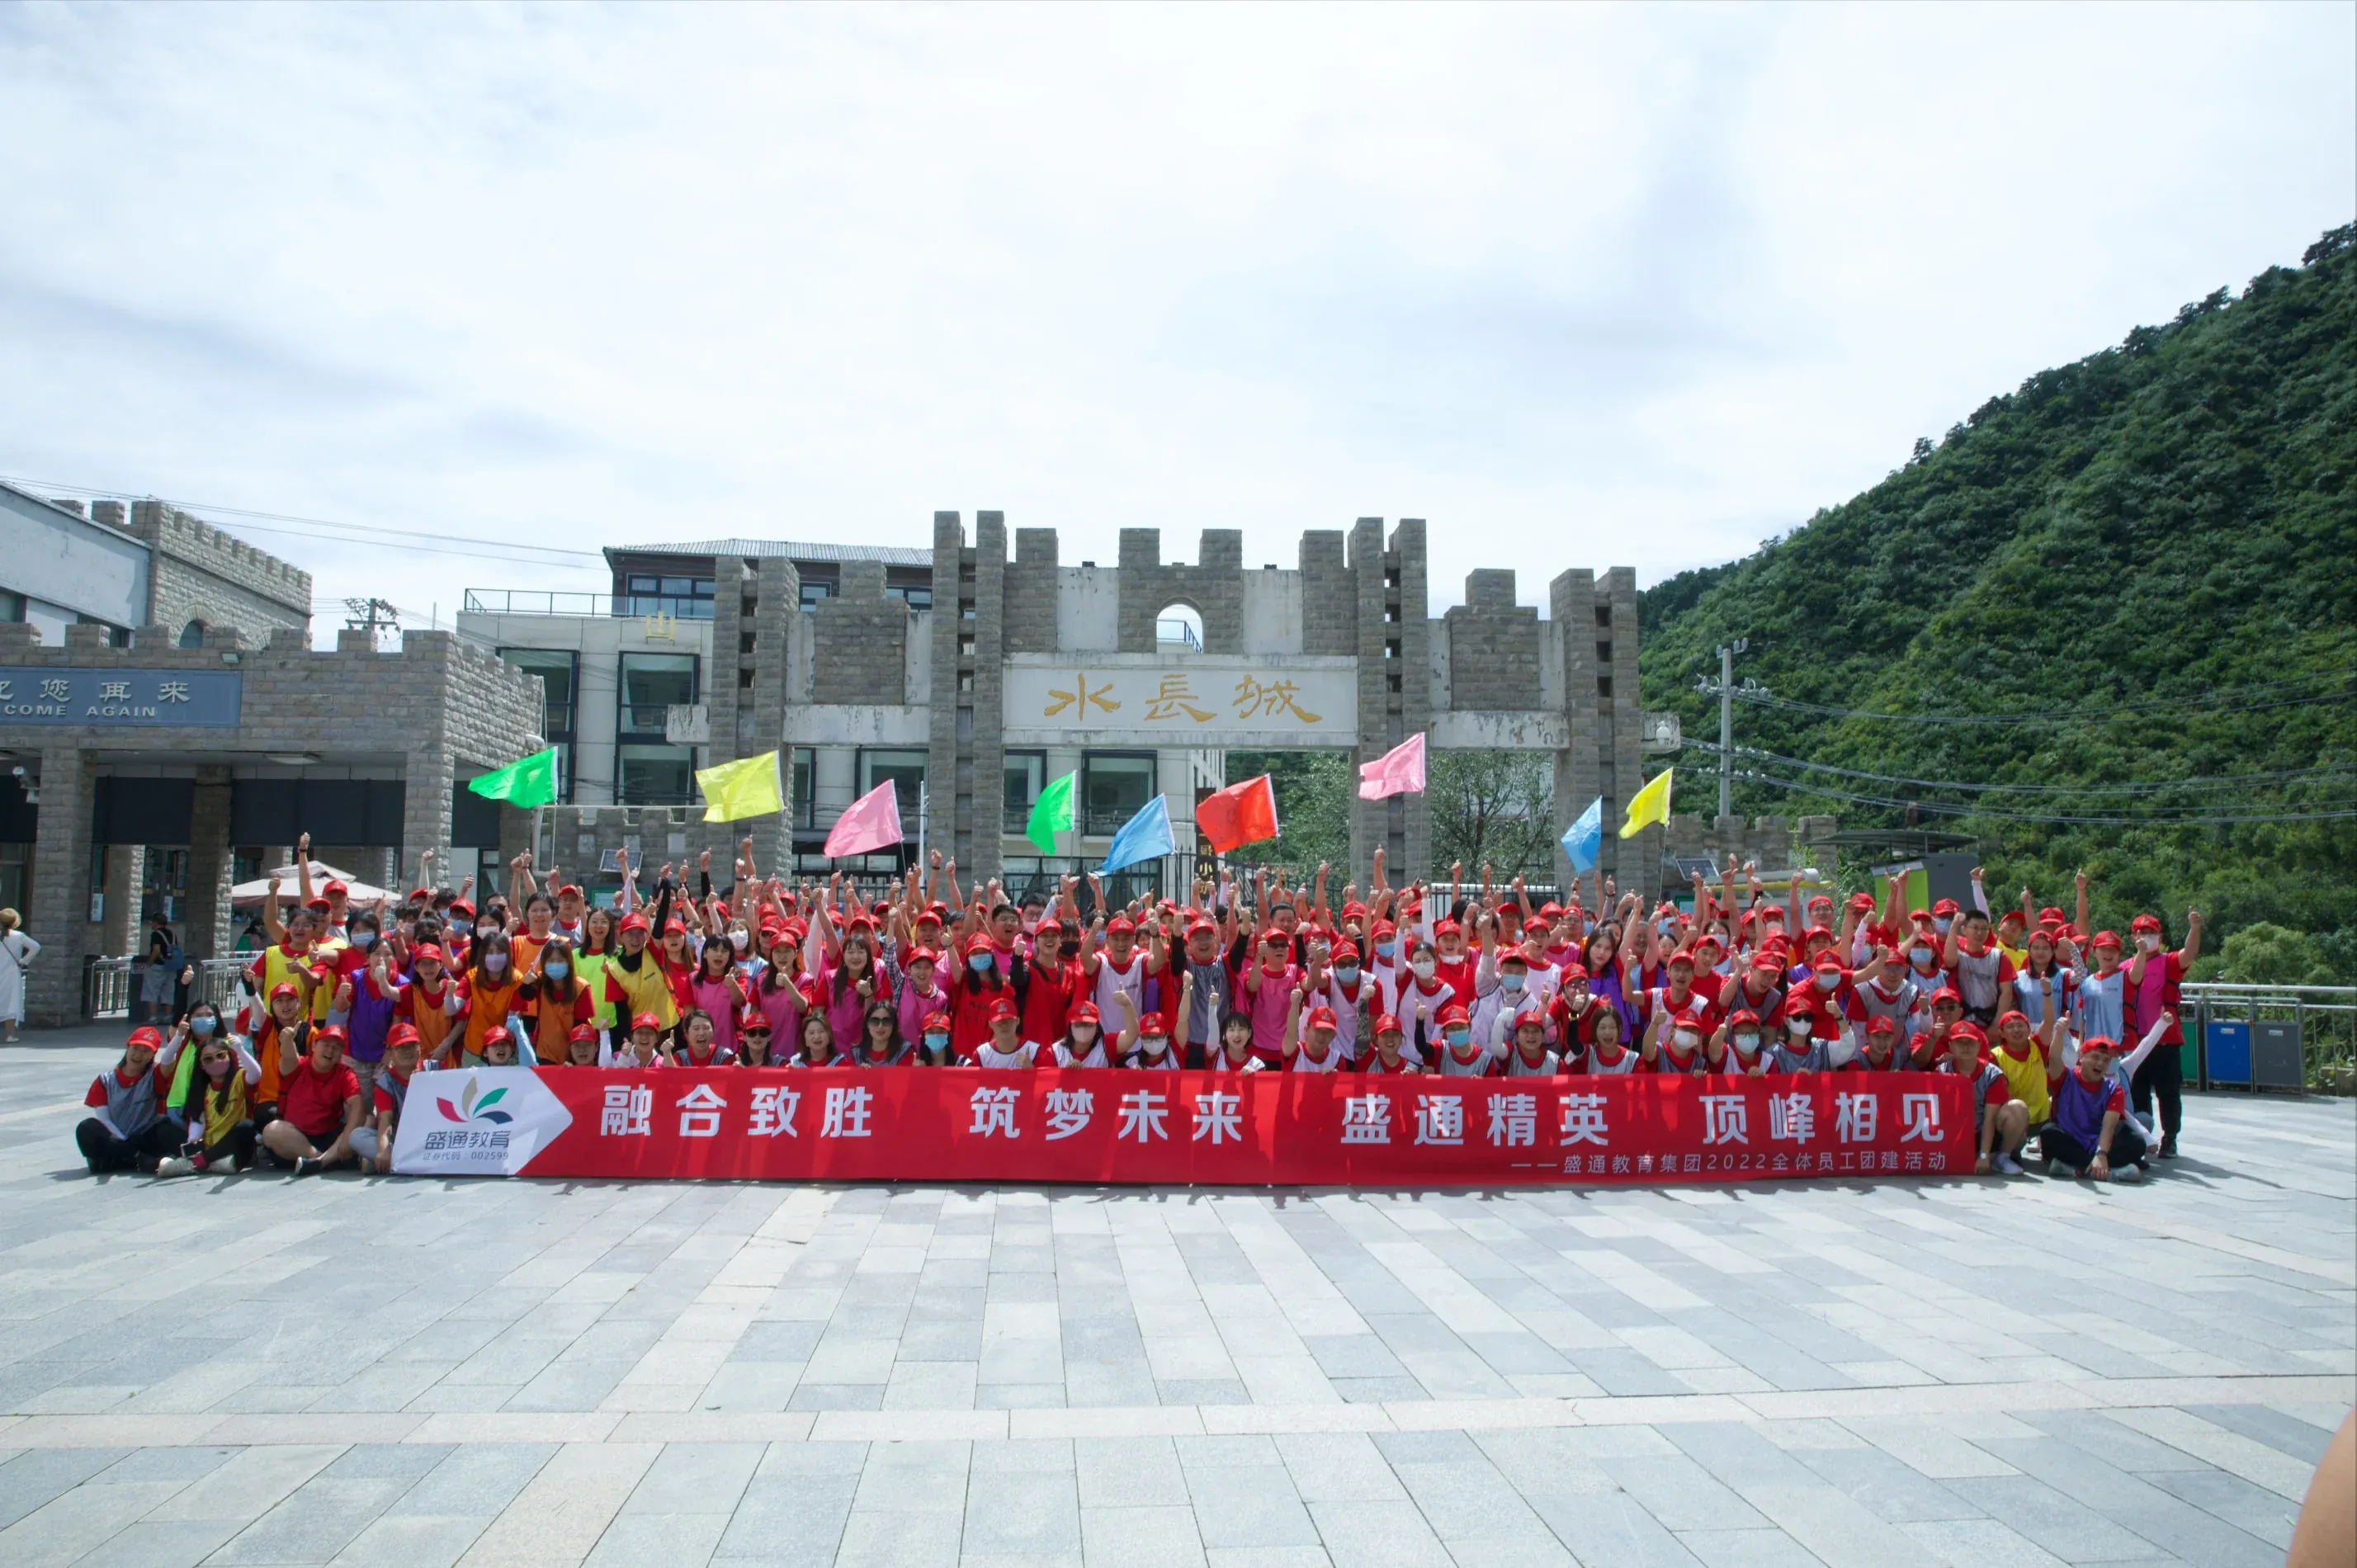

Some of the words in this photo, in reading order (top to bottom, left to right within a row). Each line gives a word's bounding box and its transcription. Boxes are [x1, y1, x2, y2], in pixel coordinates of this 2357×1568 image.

[86, 706, 157, 717] AGAIN
[601, 1084, 874, 1138] 融合致胜
[969, 1086, 1243, 1145] 筑梦未来
[1340, 1093, 1609, 1146] 盛通精英
[1698, 1092, 1944, 1145] 顶峰相见
[424, 1130, 512, 1150] 盛通教育
